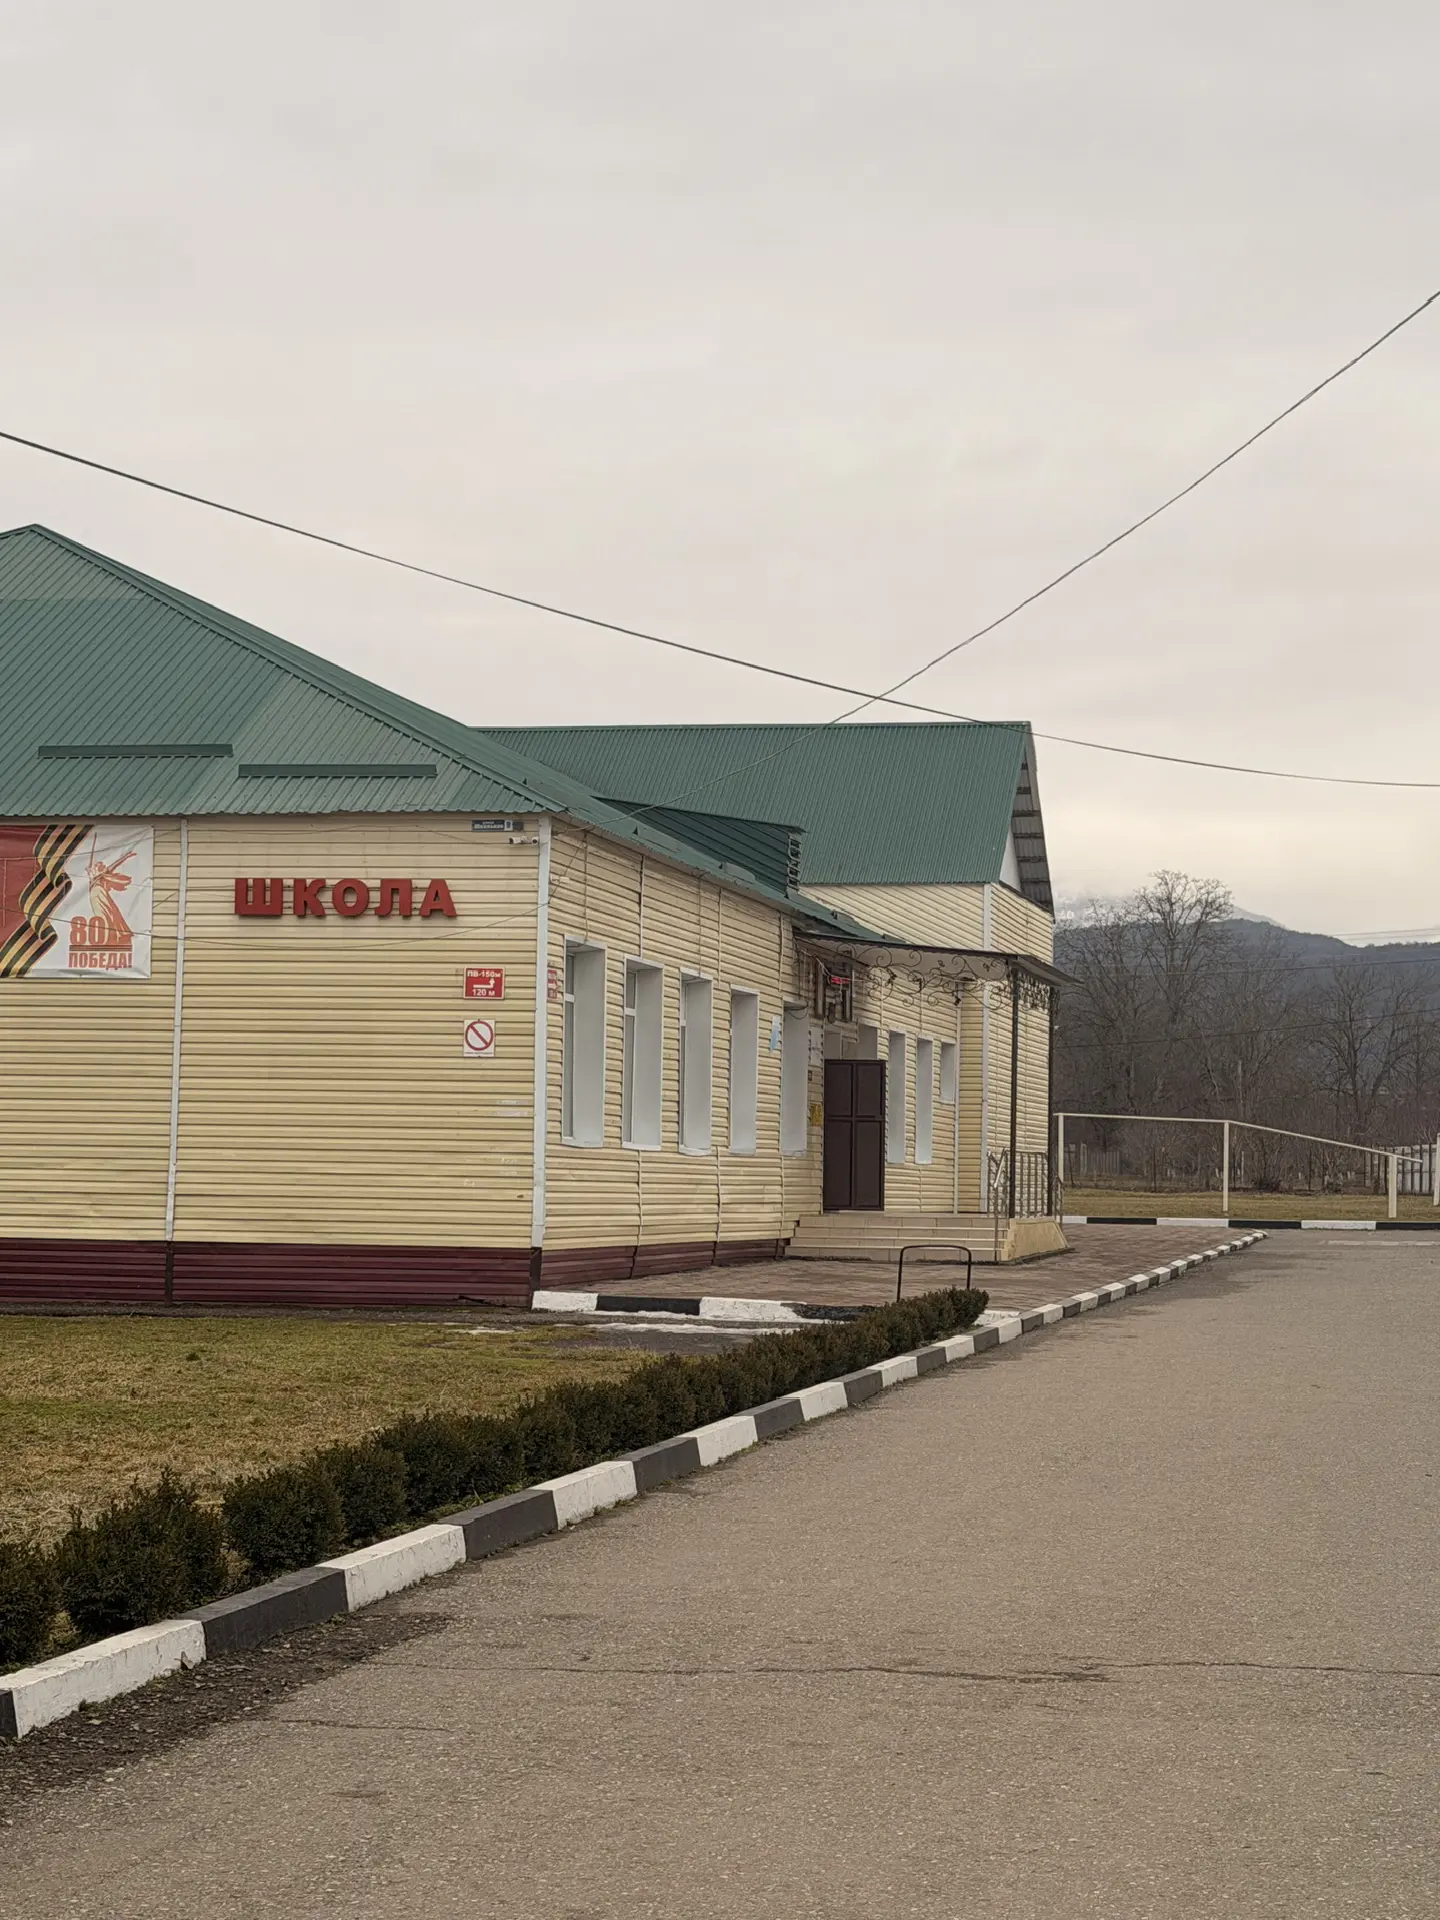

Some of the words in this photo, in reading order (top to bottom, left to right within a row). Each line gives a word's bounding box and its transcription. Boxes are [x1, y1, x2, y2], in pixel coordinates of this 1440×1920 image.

[234, 878, 457, 918] ШКОЛА
[70, 916, 106, 945] 80
[68, 952, 133, 970] ПОБЕДА!
